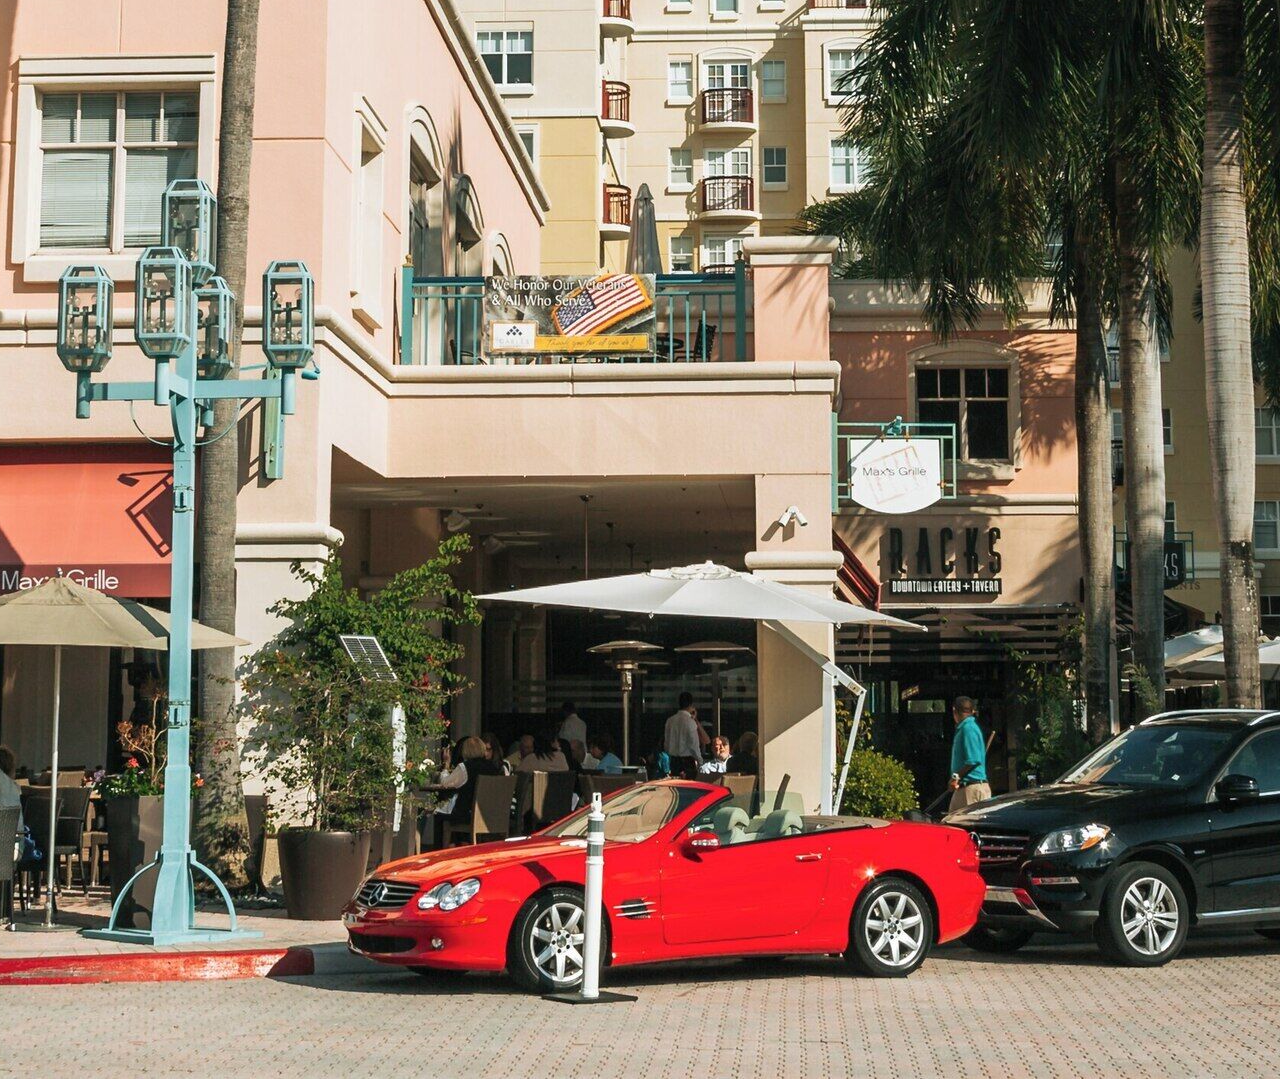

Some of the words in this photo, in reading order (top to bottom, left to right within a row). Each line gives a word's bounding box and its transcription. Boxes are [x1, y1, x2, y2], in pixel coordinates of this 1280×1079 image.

[492, 279, 512, 291] We
[513, 279, 549, 291] Honor
[552, 279, 574, 291] Our
[577, 278, 626, 291] Veterans
[492, 295, 501, 306] &
[504, 294, 521, 307] All
[524, 294, 552, 307] Who
[554, 295, 586, 307] Serve
[862, 467, 895, 476] Max's
[898, 466, 927, 476] Grille
[889, 526, 1001, 574] RACKS
[892, 580, 932, 593] DOWNTOWN
[933, 580, 961, 593] EATERY
[971, 580, 999, 593] TAVERN
